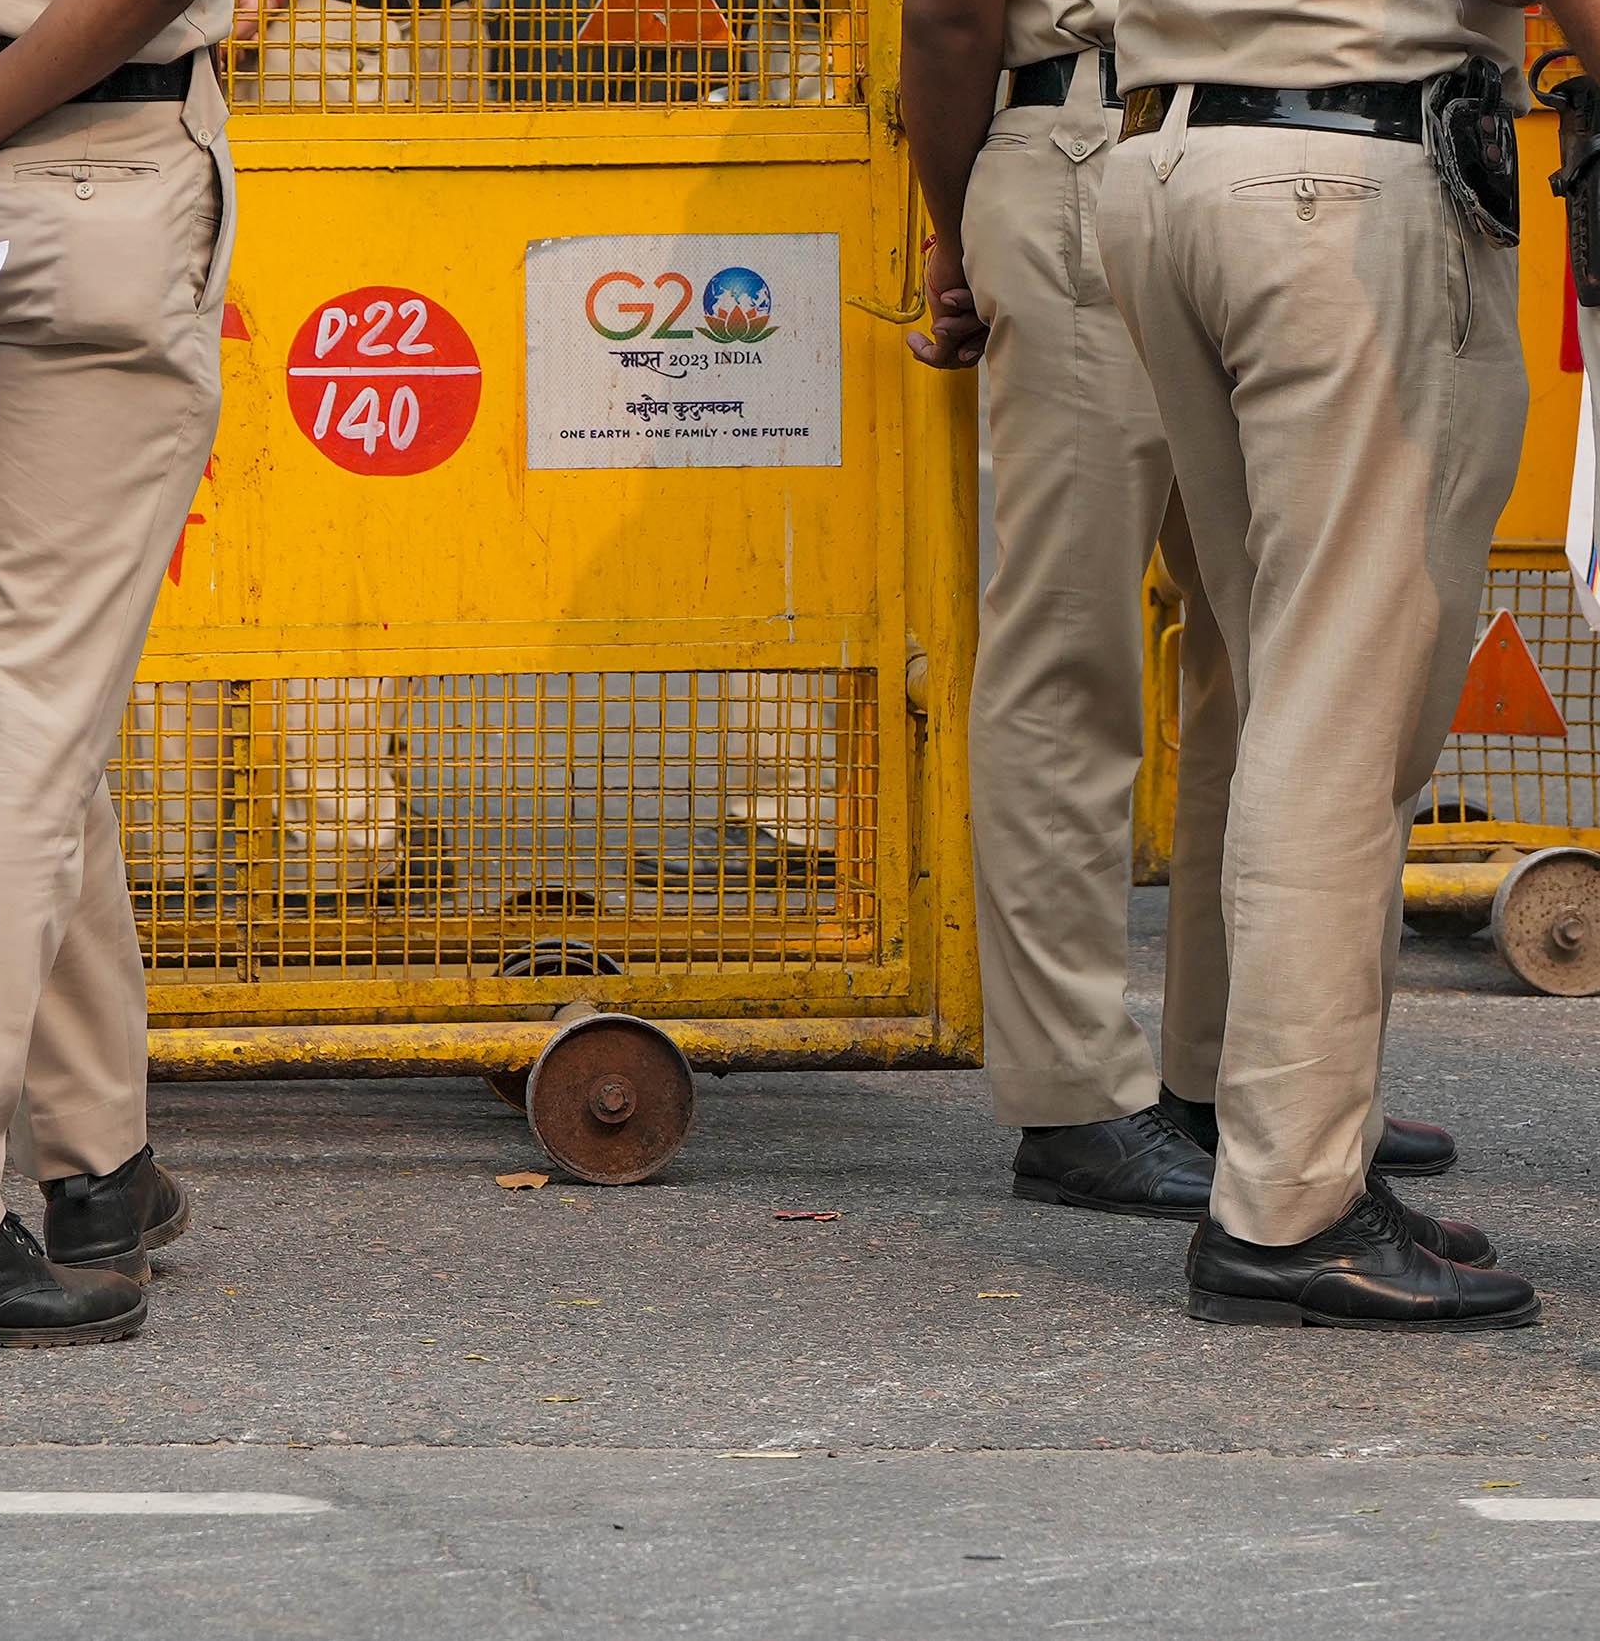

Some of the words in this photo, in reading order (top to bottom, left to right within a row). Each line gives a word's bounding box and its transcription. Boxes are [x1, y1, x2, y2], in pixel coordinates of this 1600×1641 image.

[669, 355, 708, 369] 2023
[714, 351, 763, 365] INDIA
[313, 381, 420, 456] 140
[560, 429, 585, 439] ONE
[590, 429, 631, 439] EARTH
[645, 428, 670, 438] ONE
[675, 428, 718, 438] FAMILY
[732, 428, 758, 438] ONE
[762, 427, 810, 437] FUTURE
